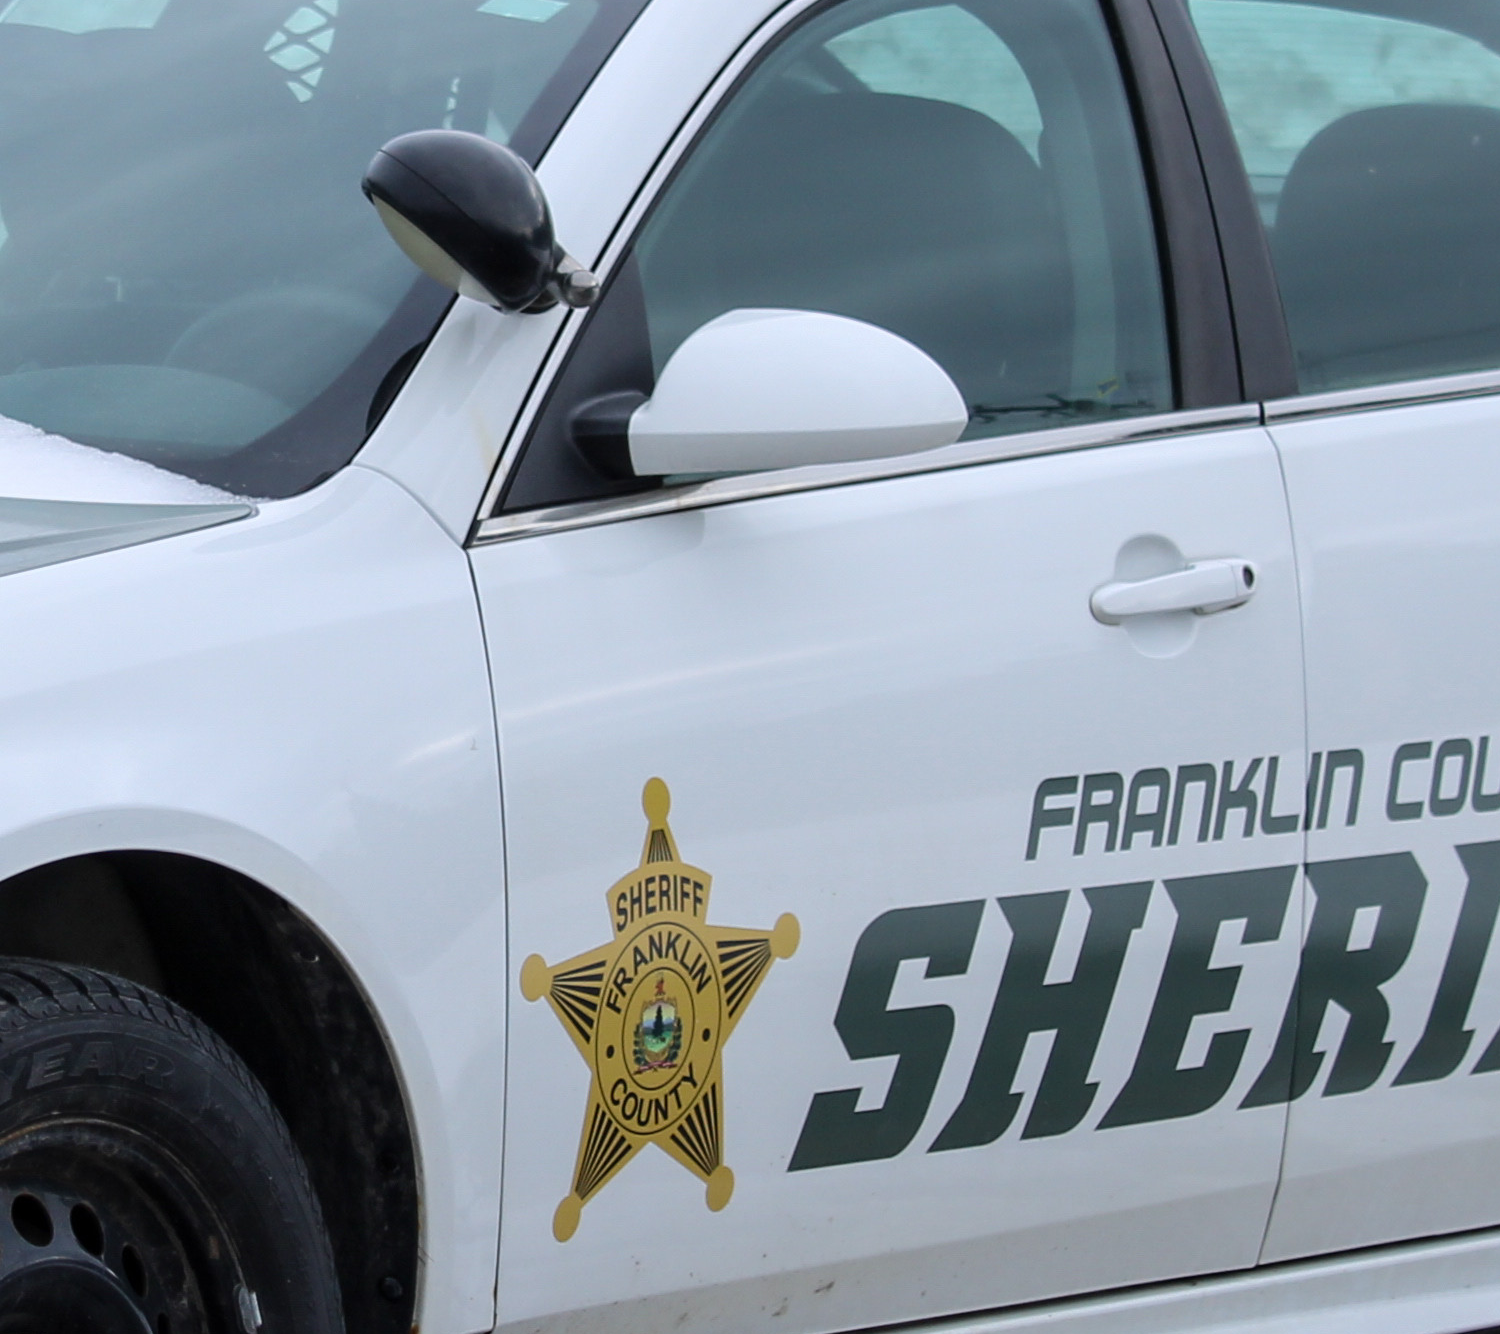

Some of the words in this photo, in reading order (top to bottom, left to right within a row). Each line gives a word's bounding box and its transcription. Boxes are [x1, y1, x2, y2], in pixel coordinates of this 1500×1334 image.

[1024, 748, 1365, 862] FRANKLIN
[616, 874, 704, 932] SHERIFF
[605, 931, 712, 1014] FRANKLIN
[610, 1064, 699, 1127] COUNTY
